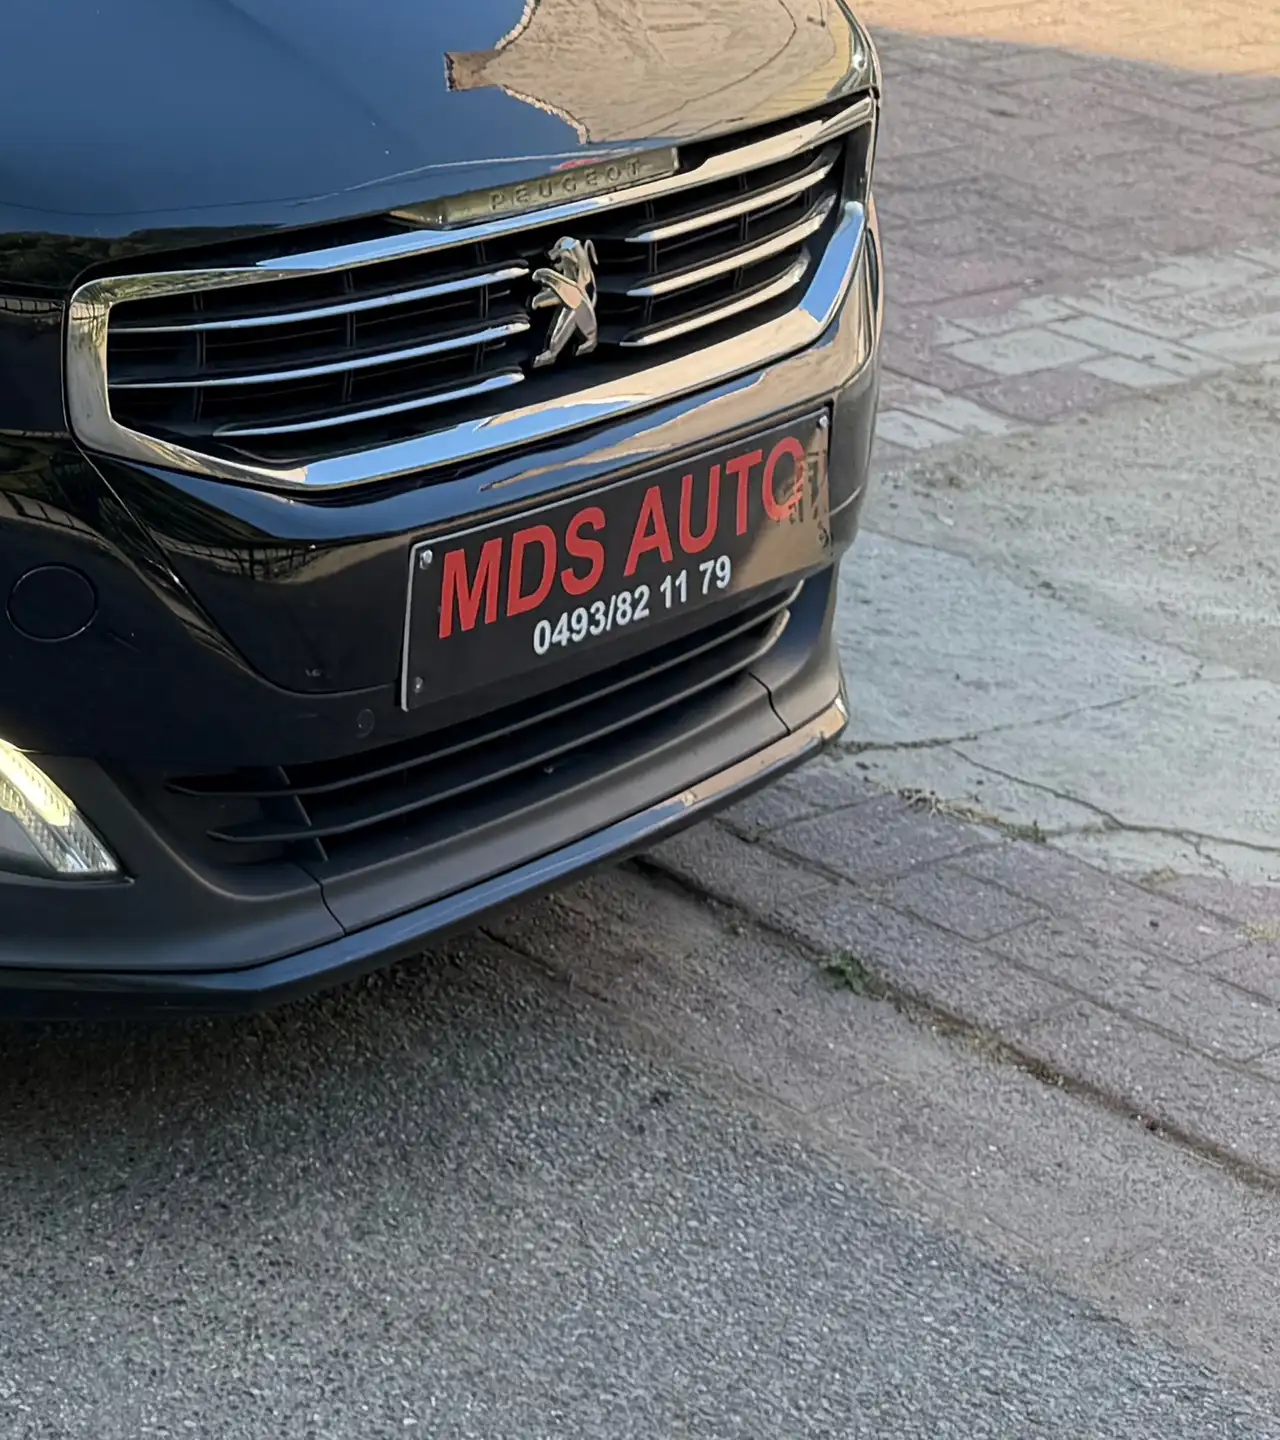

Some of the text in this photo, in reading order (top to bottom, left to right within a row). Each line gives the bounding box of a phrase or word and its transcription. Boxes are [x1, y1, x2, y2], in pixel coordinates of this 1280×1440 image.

[490, 158, 640, 210] PEUGEOT
[440, 436, 805, 639] MDS AUTO
[533, 555, 732, 656] 0493/82 11 79
